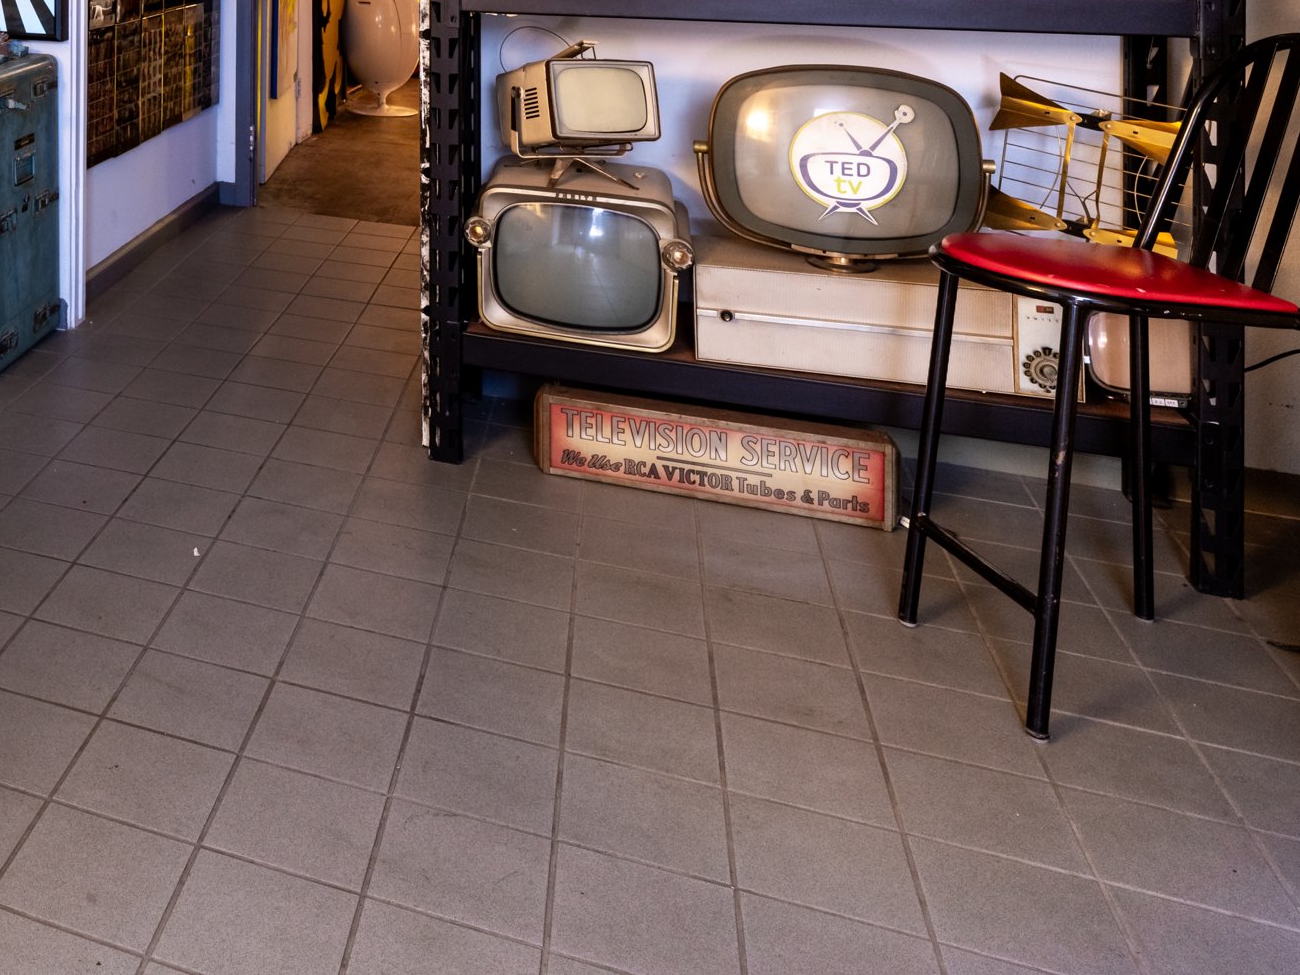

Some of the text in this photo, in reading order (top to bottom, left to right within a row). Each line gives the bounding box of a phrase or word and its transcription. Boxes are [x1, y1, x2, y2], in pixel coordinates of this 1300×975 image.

[824, 160, 871, 178] TED
[833, 176, 863, 196] tv
[560, 407, 871, 485] TELEVISION SERVICE
[561, 448, 870, 514] We Use RCA VICTOR Tubes & Parts
